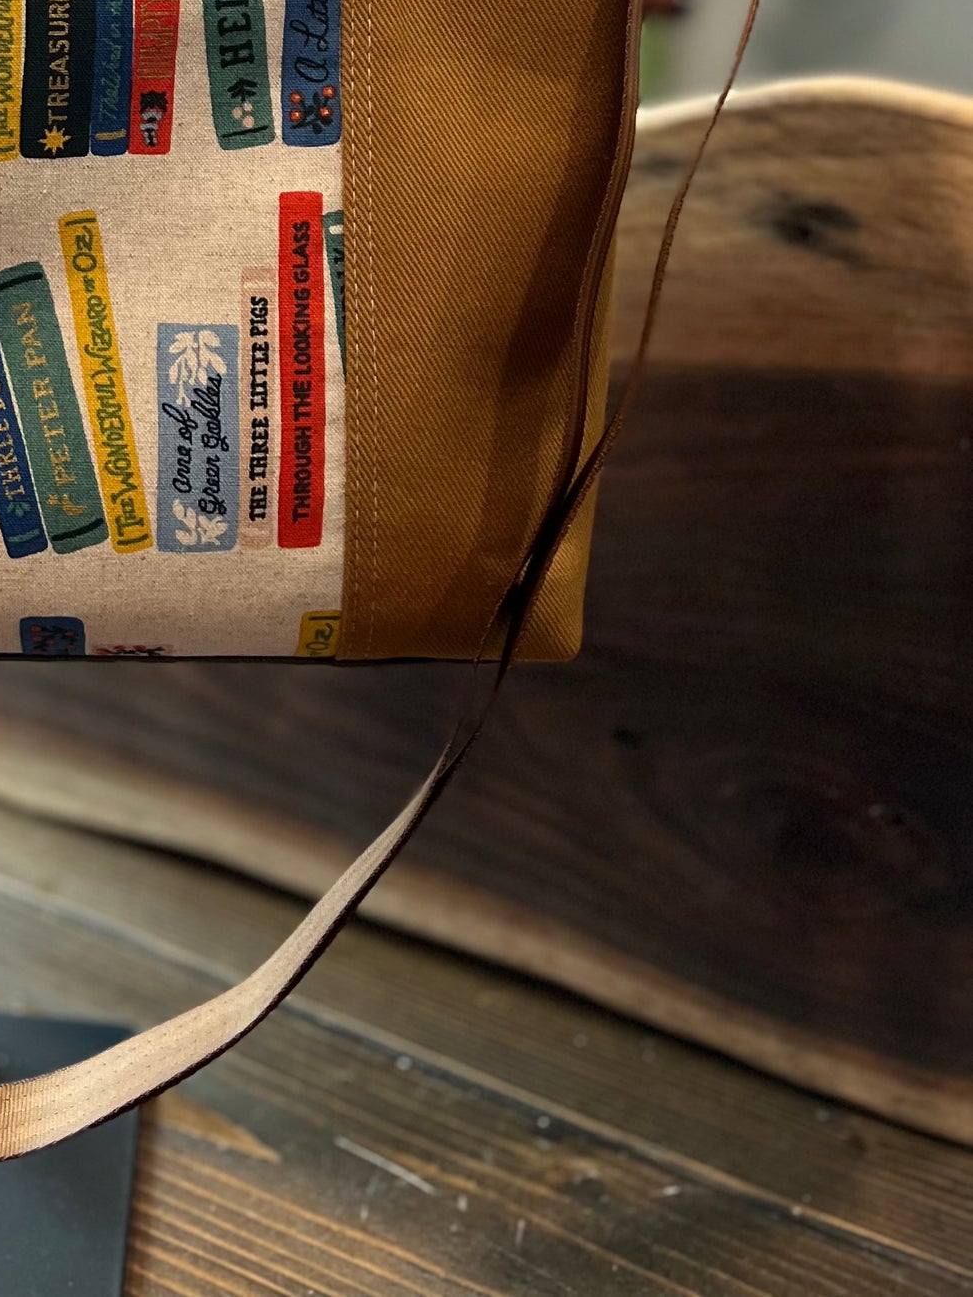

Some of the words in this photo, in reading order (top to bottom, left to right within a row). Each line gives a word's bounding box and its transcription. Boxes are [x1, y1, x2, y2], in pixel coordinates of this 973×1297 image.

[291, 220, 312, 283] GLASS
[12, 302, 49, 369] PAN
[250, 295, 268, 338] PIGS
[291, 289, 313, 376] LOOKING
[250, 342, 270, 411] LITTLE
[291, 380, 312, 423] THE
[32, 376, 77, 487] PETER
[161, 402, 198, 445] of
[191, 373, 229, 452] Gables
[250, 416, 269, 482] THREE
[291, 426, 312, 523] THROUGH
[197, 454, 227, 516] Green
[250, 488, 268, 522] THE
